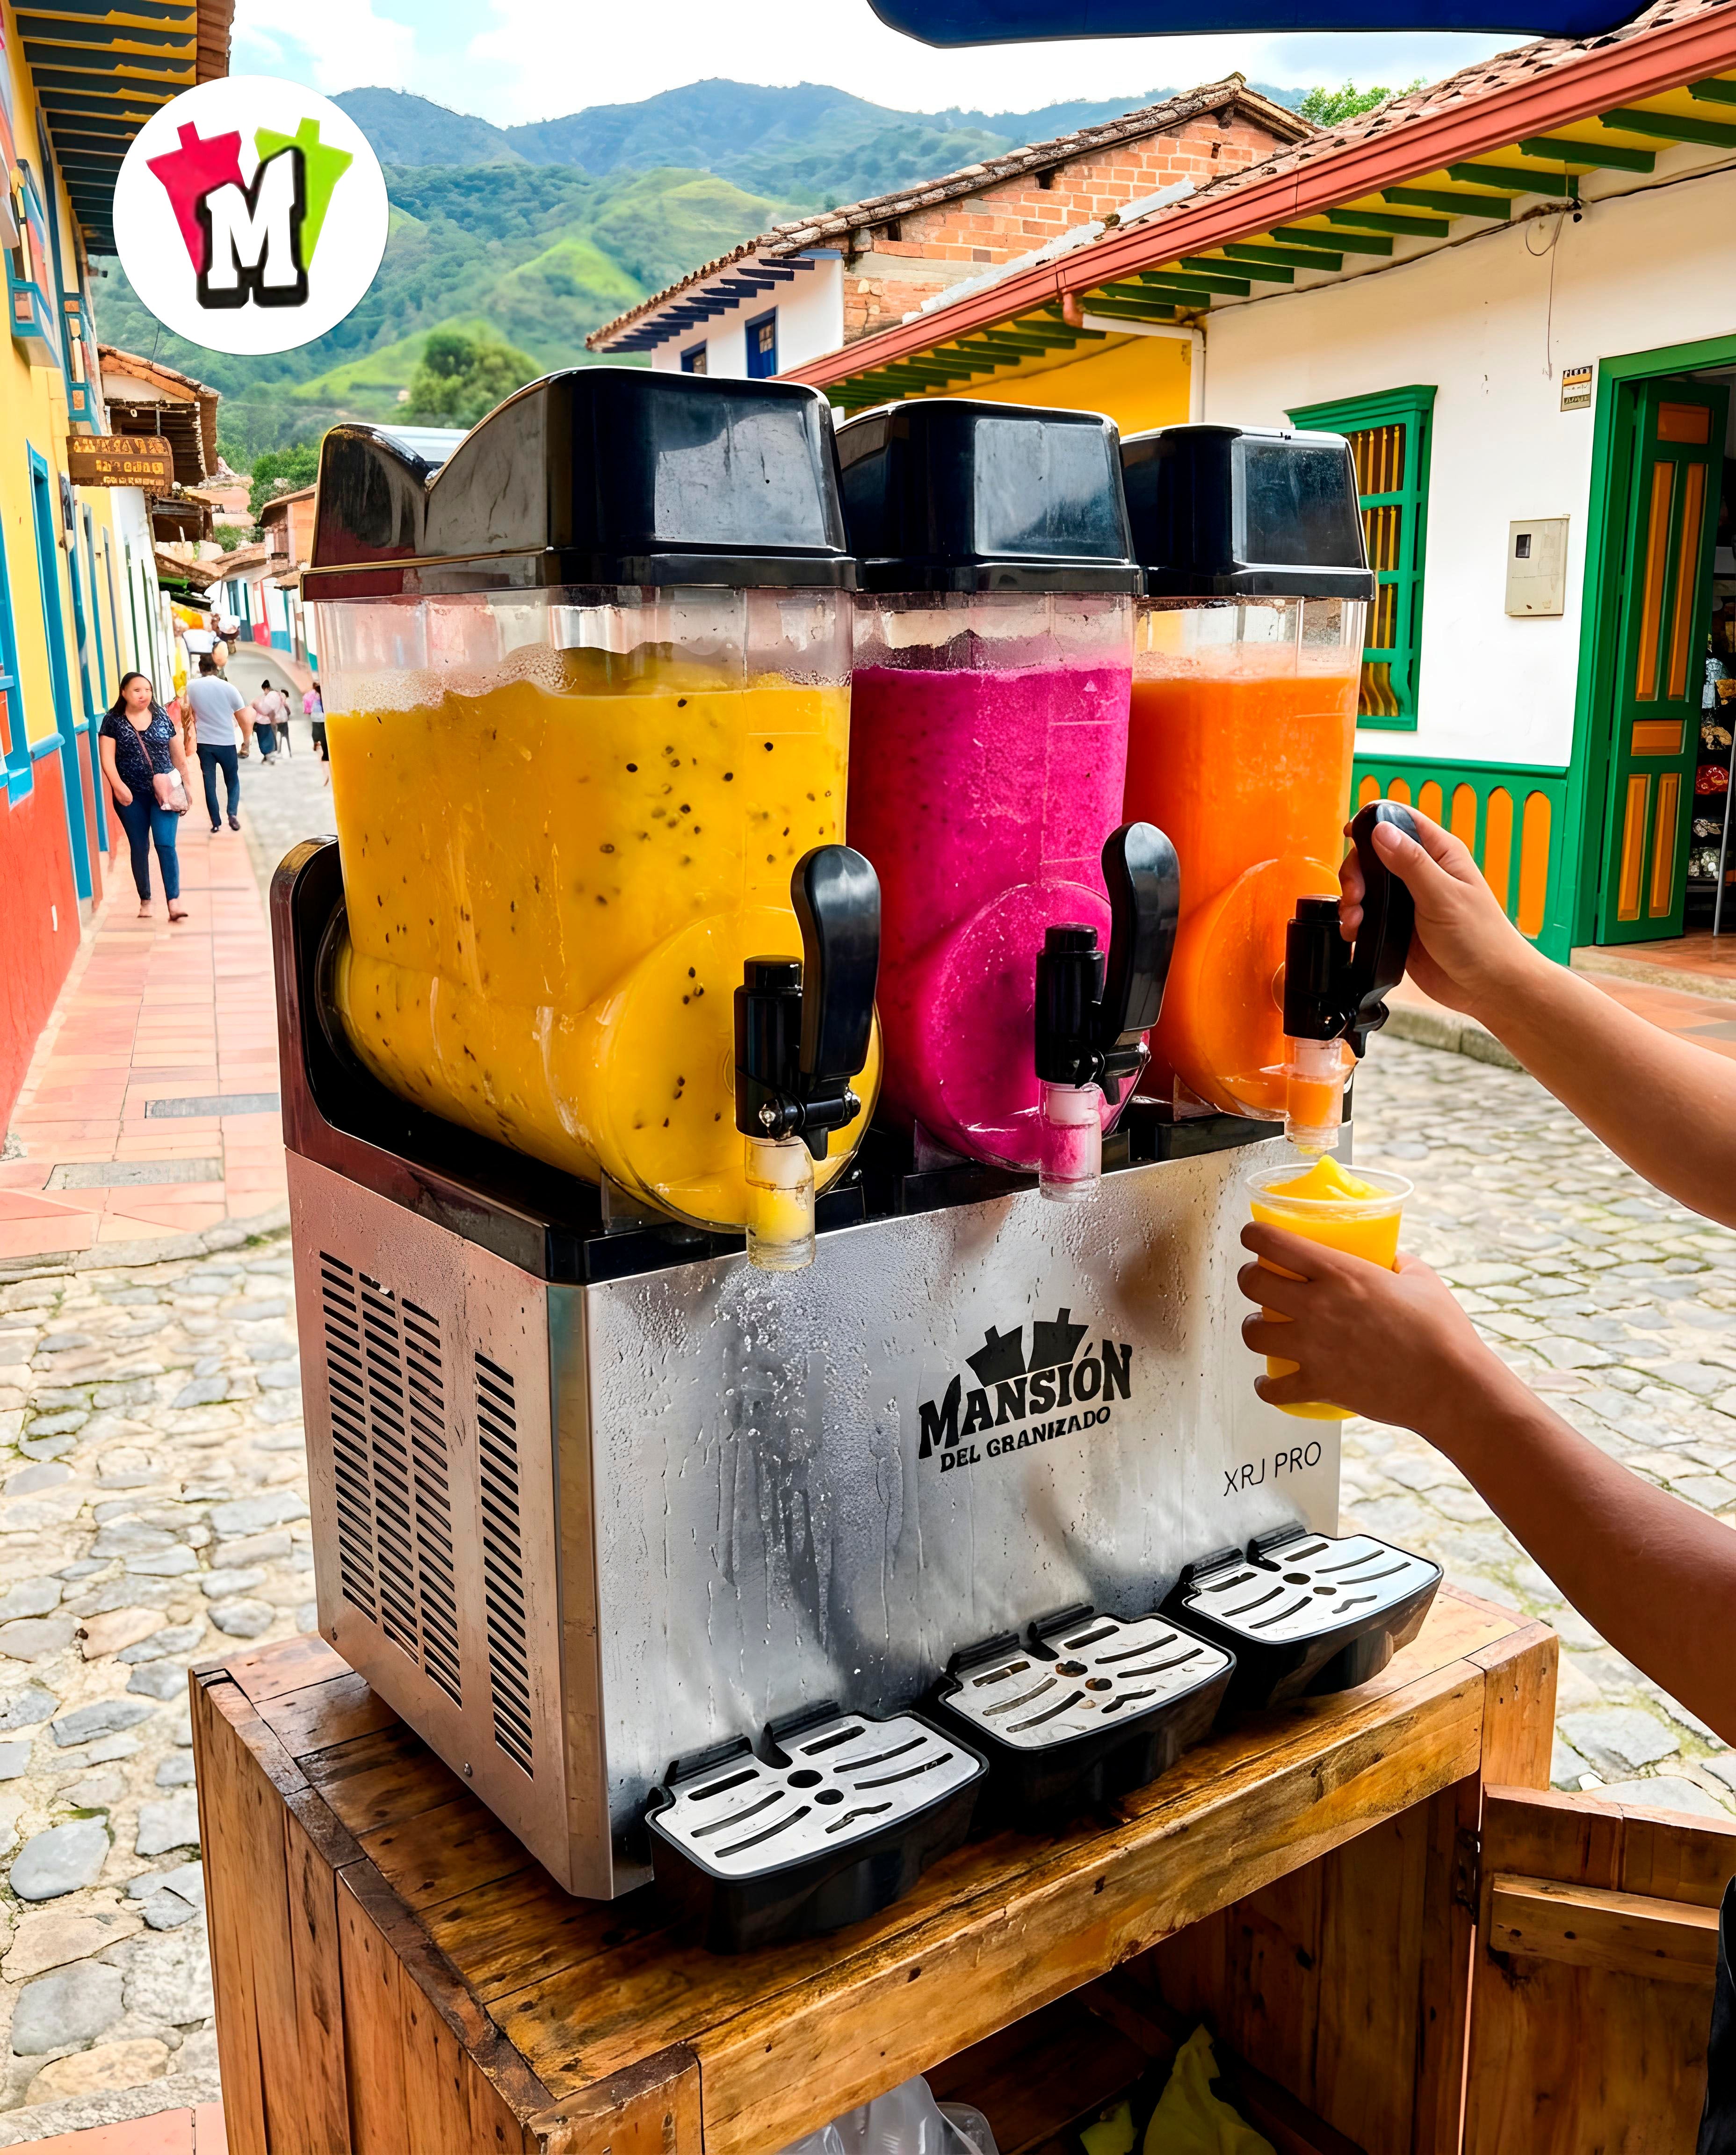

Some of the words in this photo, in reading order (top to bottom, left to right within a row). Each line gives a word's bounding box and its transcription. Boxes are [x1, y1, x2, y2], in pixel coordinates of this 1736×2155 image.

[919, 1338, 1133, 1460] MANSIÓN
[940, 1444, 981, 1473] DEL
[986, 1406, 1111, 1458] GRANIZADO
[1223, 1458, 1265, 1497] XRJ
[1275, 1441, 1322, 1478] PRO
